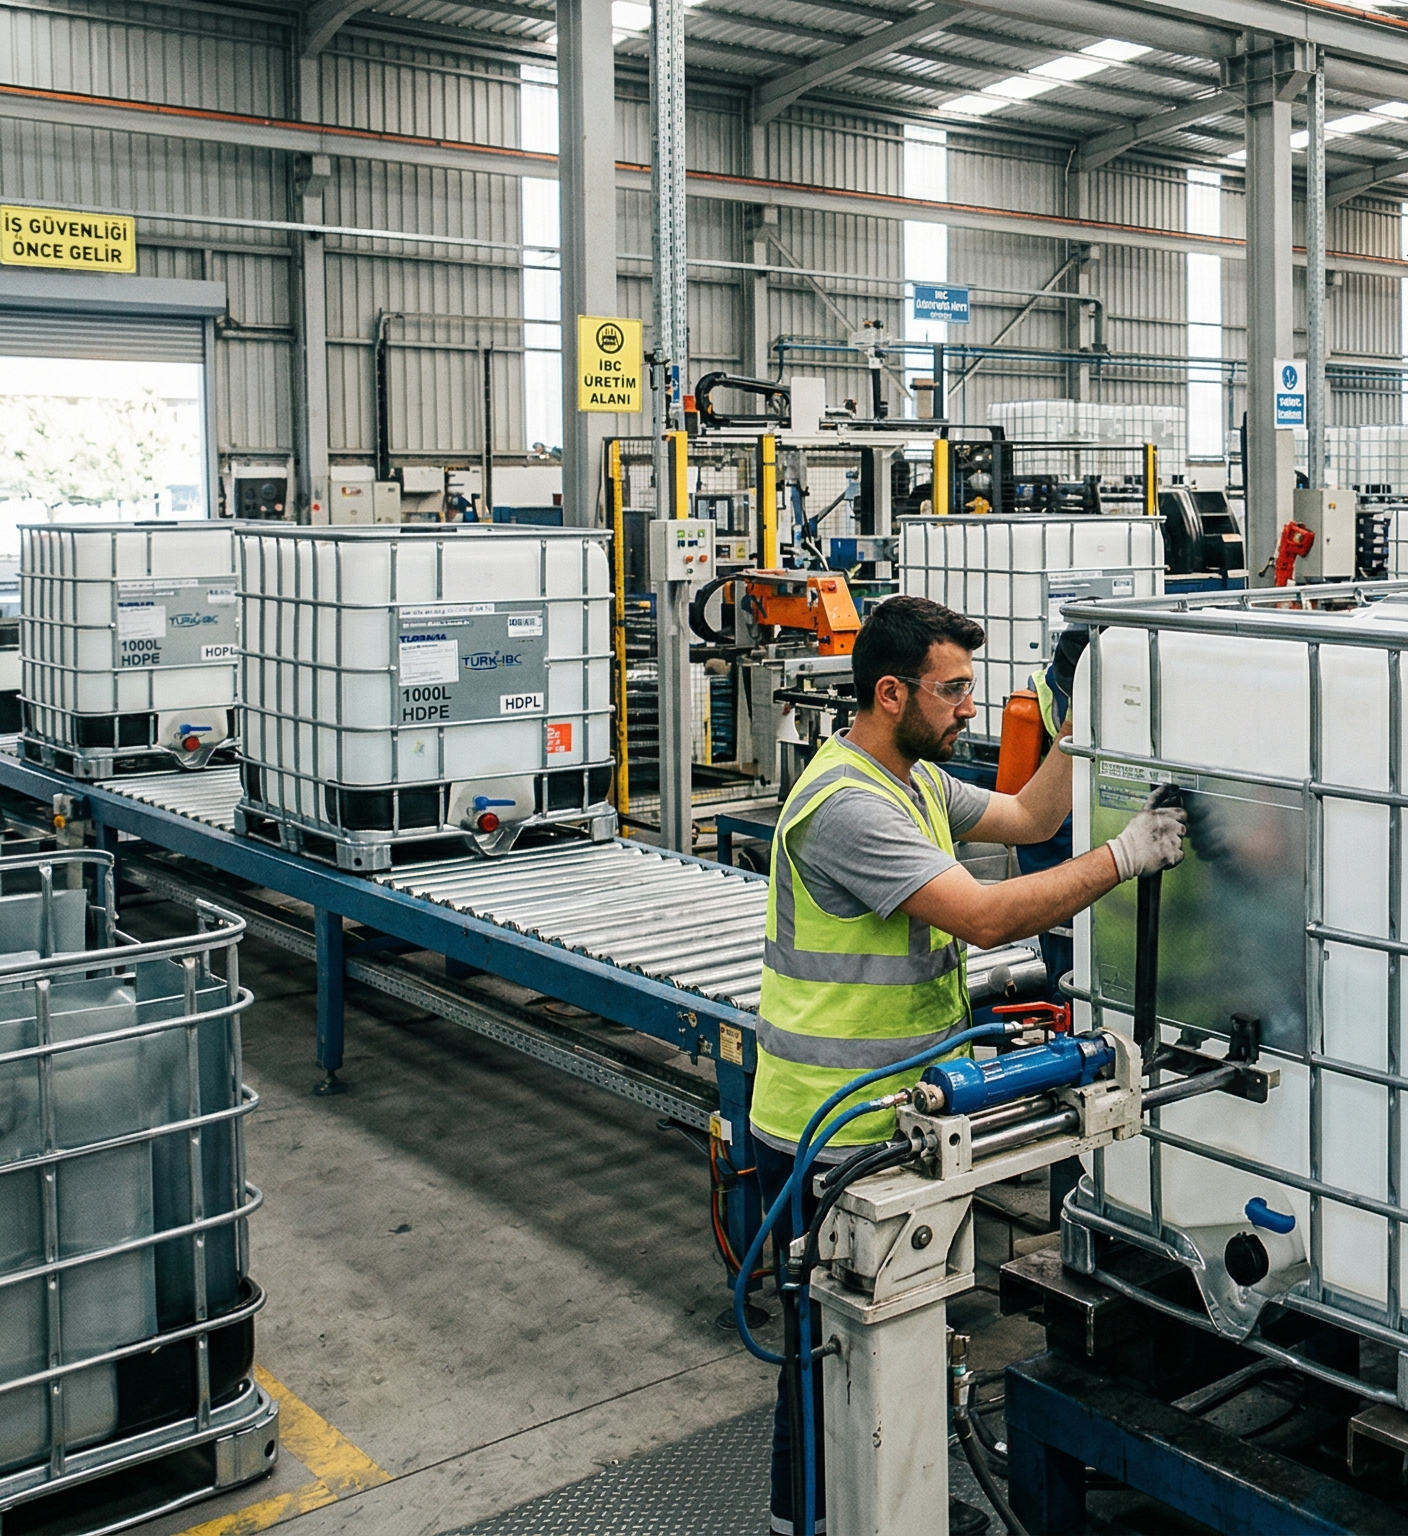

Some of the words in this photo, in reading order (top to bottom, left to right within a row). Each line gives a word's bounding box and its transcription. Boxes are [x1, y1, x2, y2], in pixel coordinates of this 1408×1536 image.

[29, 215, 127, 241] GÜVENLİĞİ
[69, 244, 122, 263] GELİR
[584, 373, 636, 389] ÜRETİM
[590, 393, 631, 405] ALANI
[121, 640, 162, 651] 1000L
[122, 652, 160, 667] HDPE
[402, 686, 452, 702] 1000L
[505, 696, 541, 710] HDPL
[403, 704, 450, 722] HDPE
